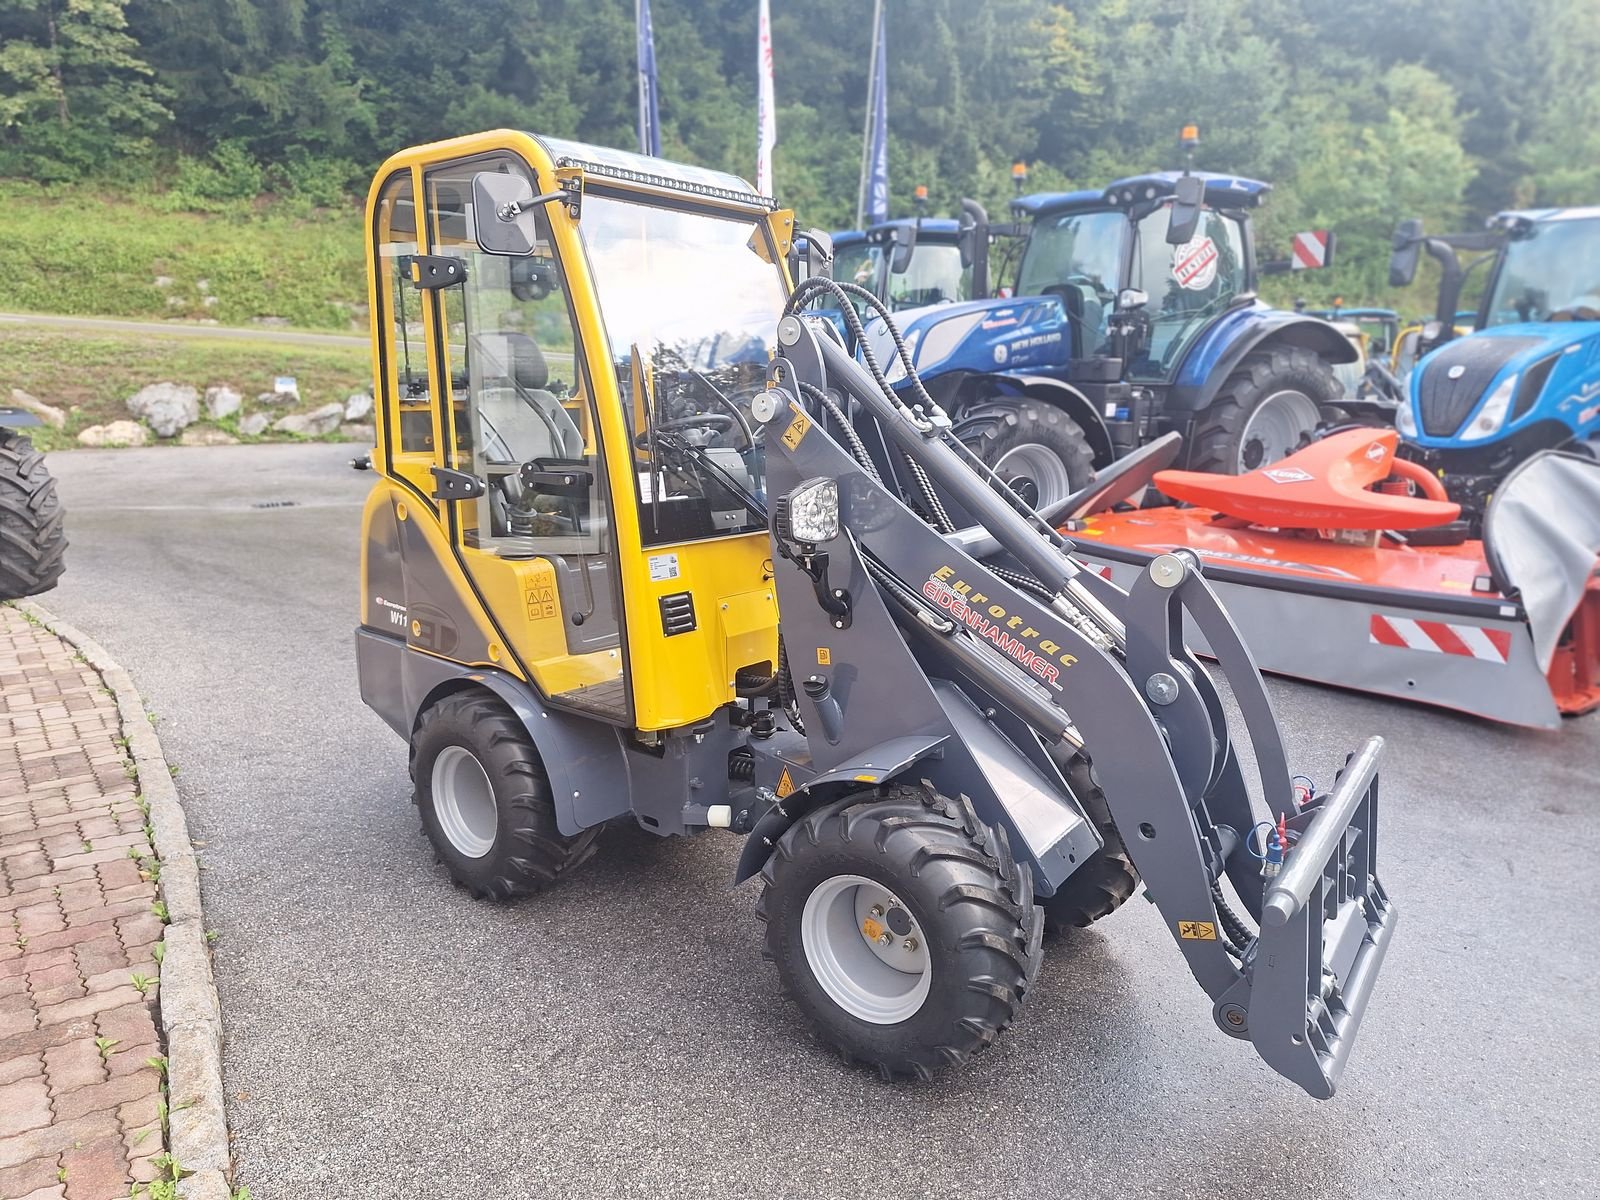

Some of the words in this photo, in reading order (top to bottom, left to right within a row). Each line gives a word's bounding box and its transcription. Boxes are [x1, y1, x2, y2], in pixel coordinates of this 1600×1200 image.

[1030, 332, 1061, 347] HOLLAND
[922, 580, 1060, 684] EIDENHAMMER
[933, 565, 1078, 667] Eurotrac
